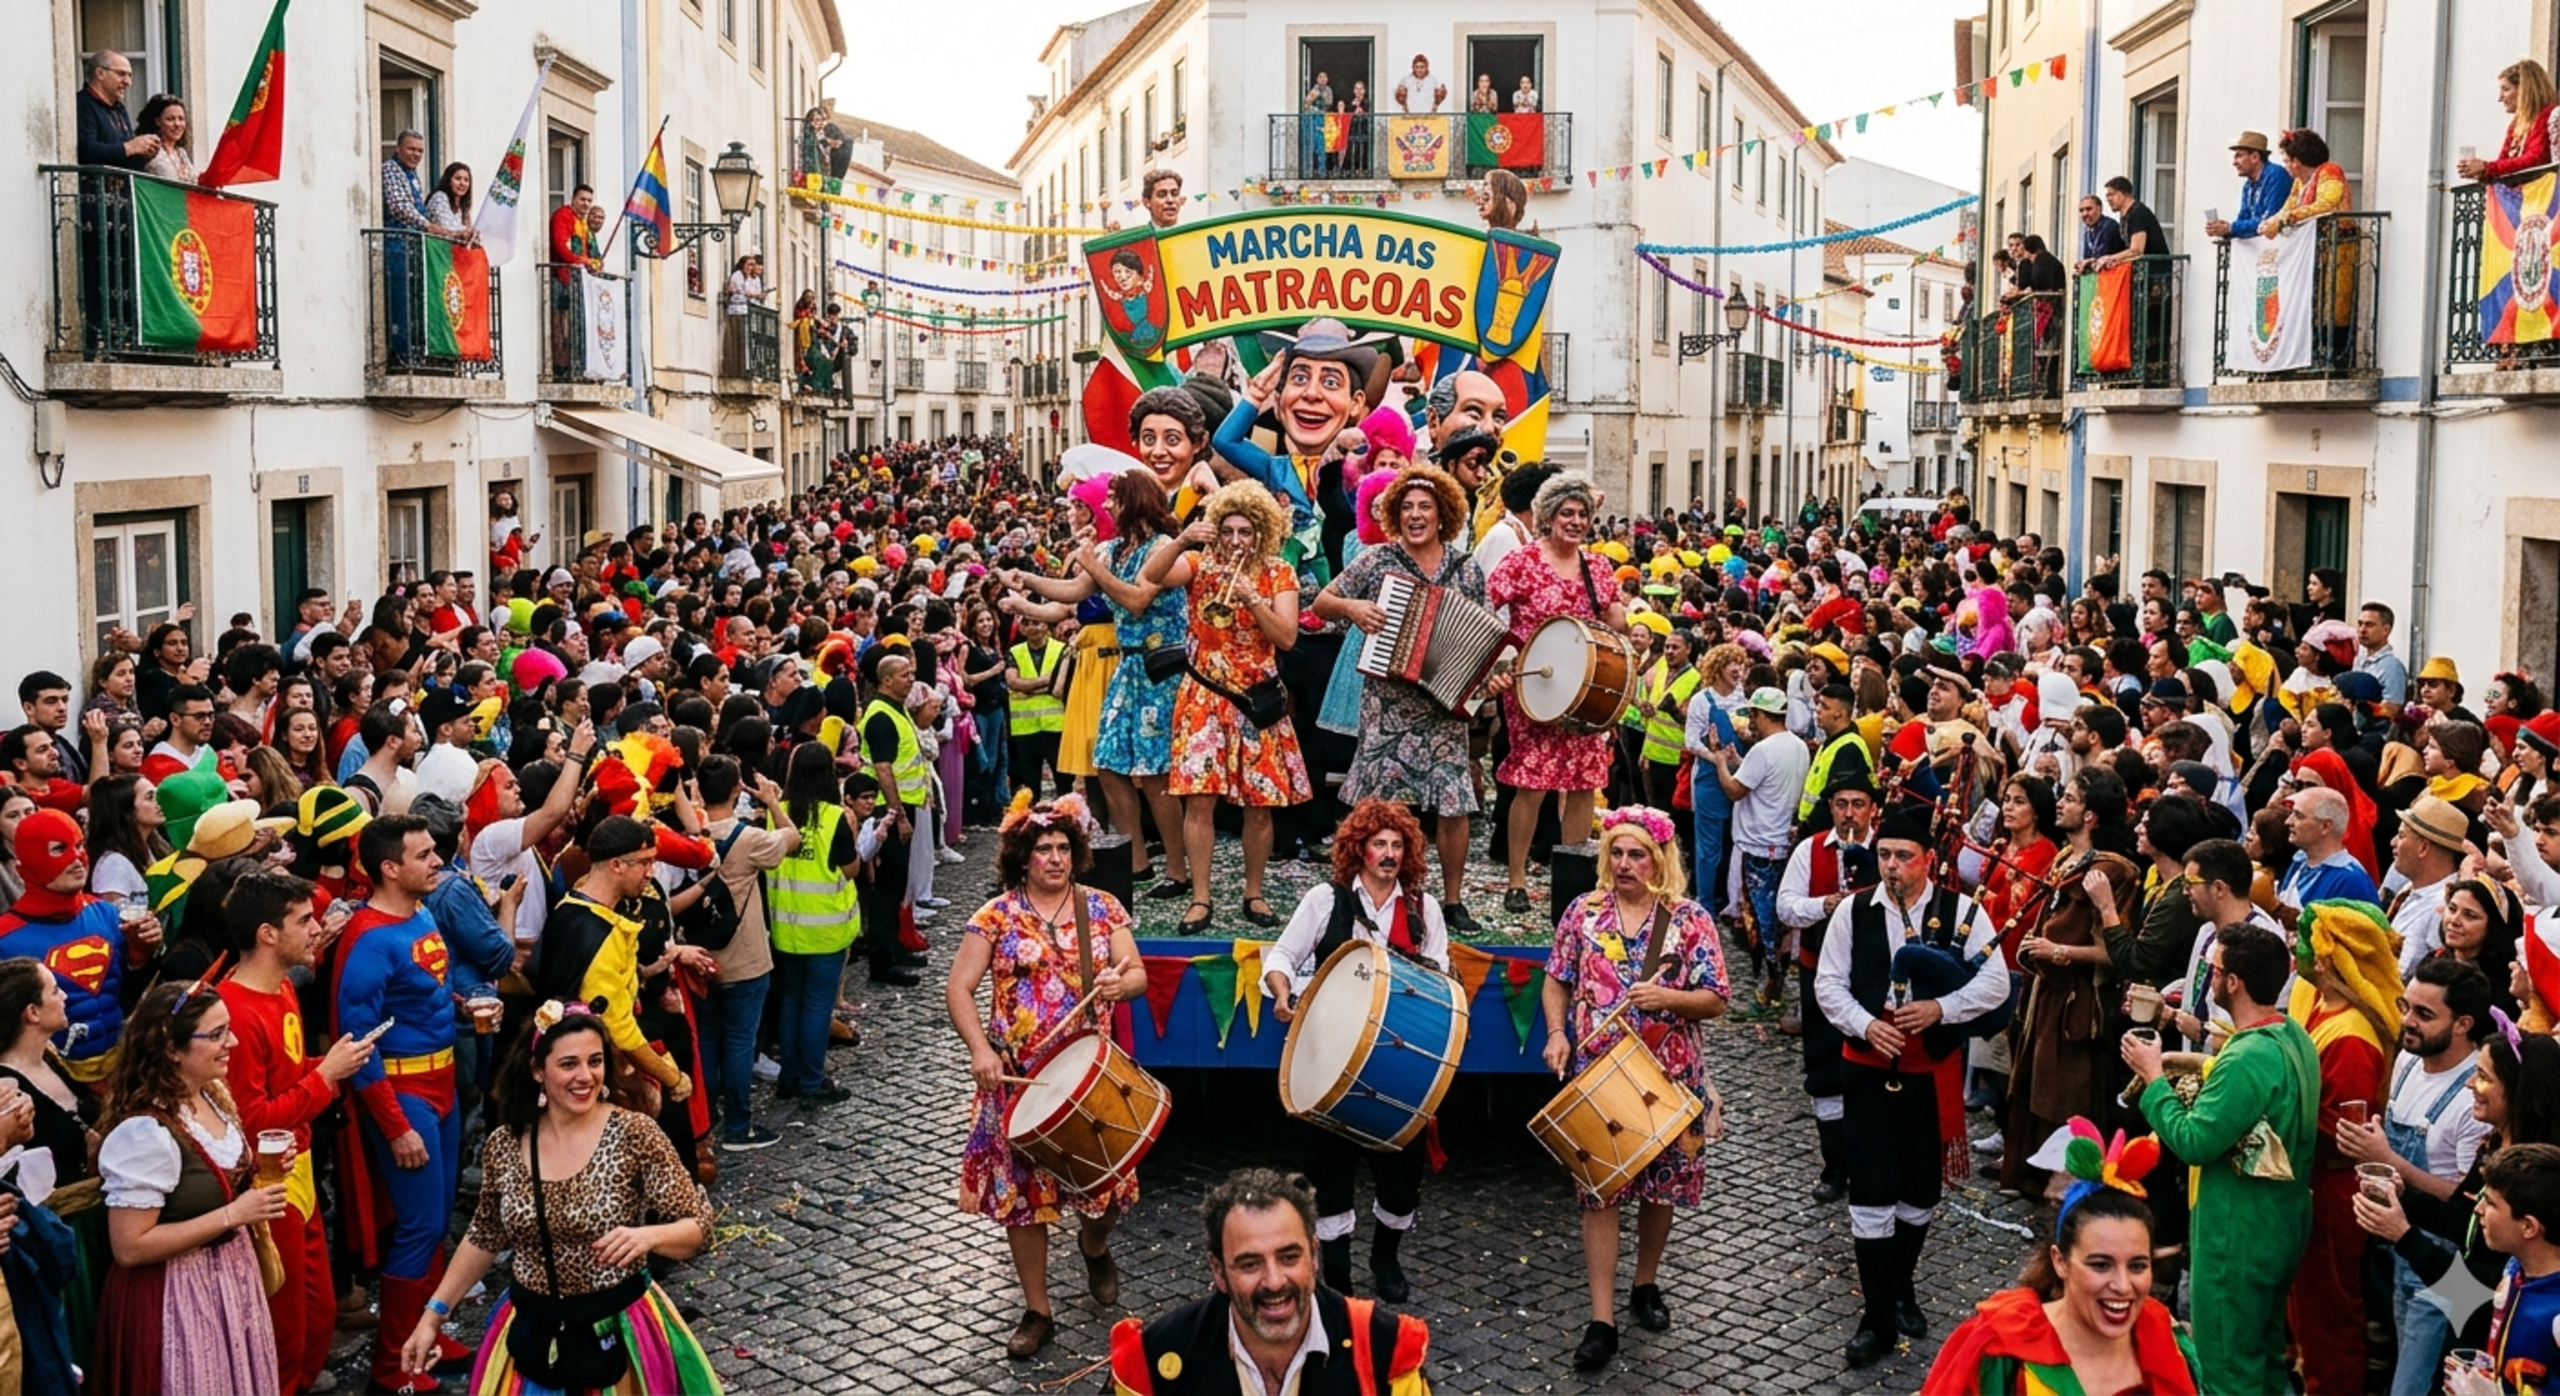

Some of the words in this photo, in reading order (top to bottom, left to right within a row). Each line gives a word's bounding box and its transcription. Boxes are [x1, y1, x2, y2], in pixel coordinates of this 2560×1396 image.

[1206, 223, 1364, 269] MARCHA
[1375, 234, 1436, 270] DAS
[1175, 266, 1468, 330] MATRACOAS
